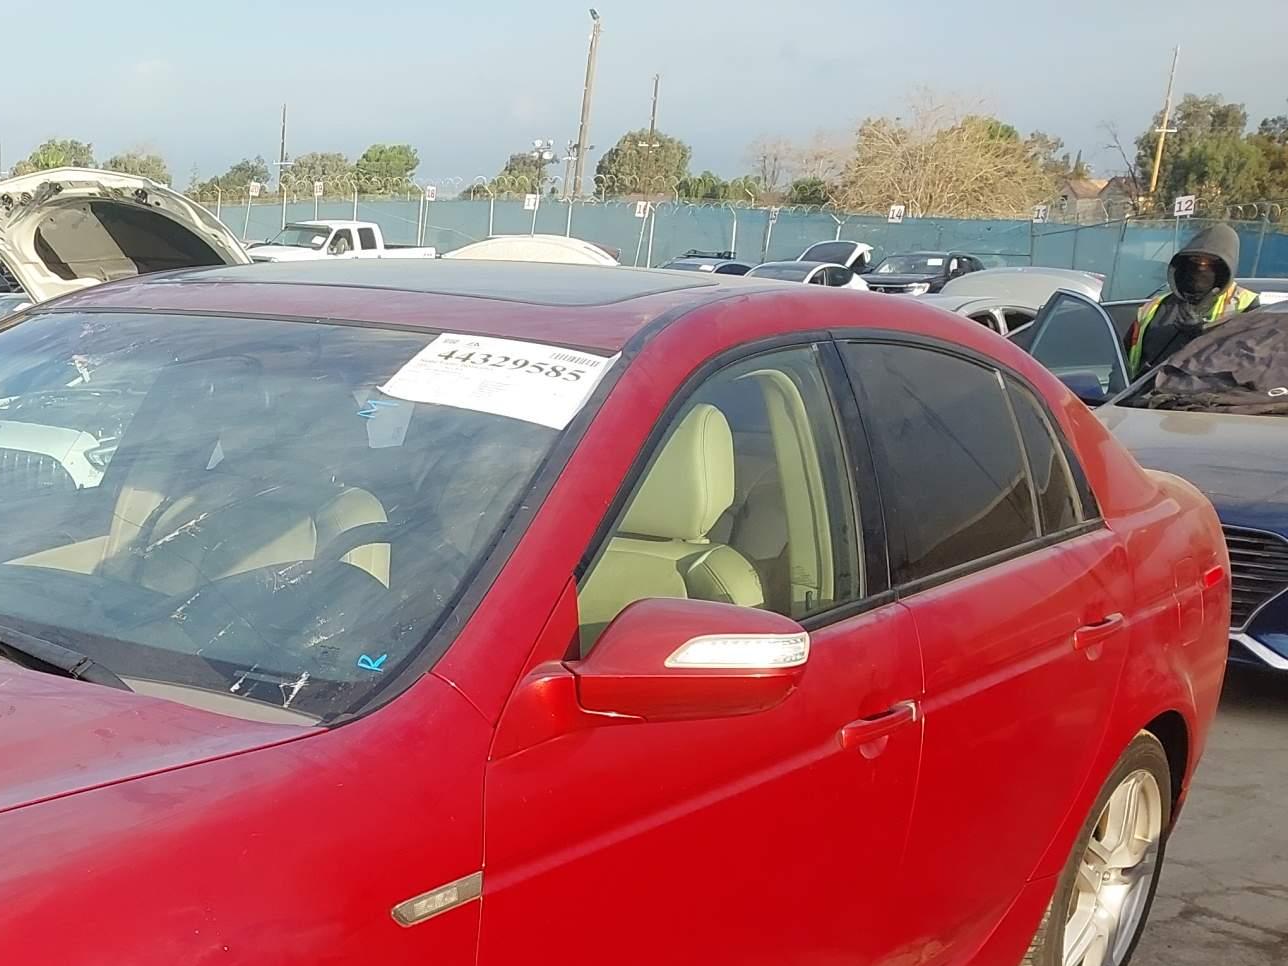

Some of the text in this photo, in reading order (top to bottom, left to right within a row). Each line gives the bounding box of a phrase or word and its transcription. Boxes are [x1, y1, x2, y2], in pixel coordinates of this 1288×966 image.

[1175, 199, 1194, 213] 12
[437, 349, 586, 382] 44329585
[357, 653, 388, 672] R
